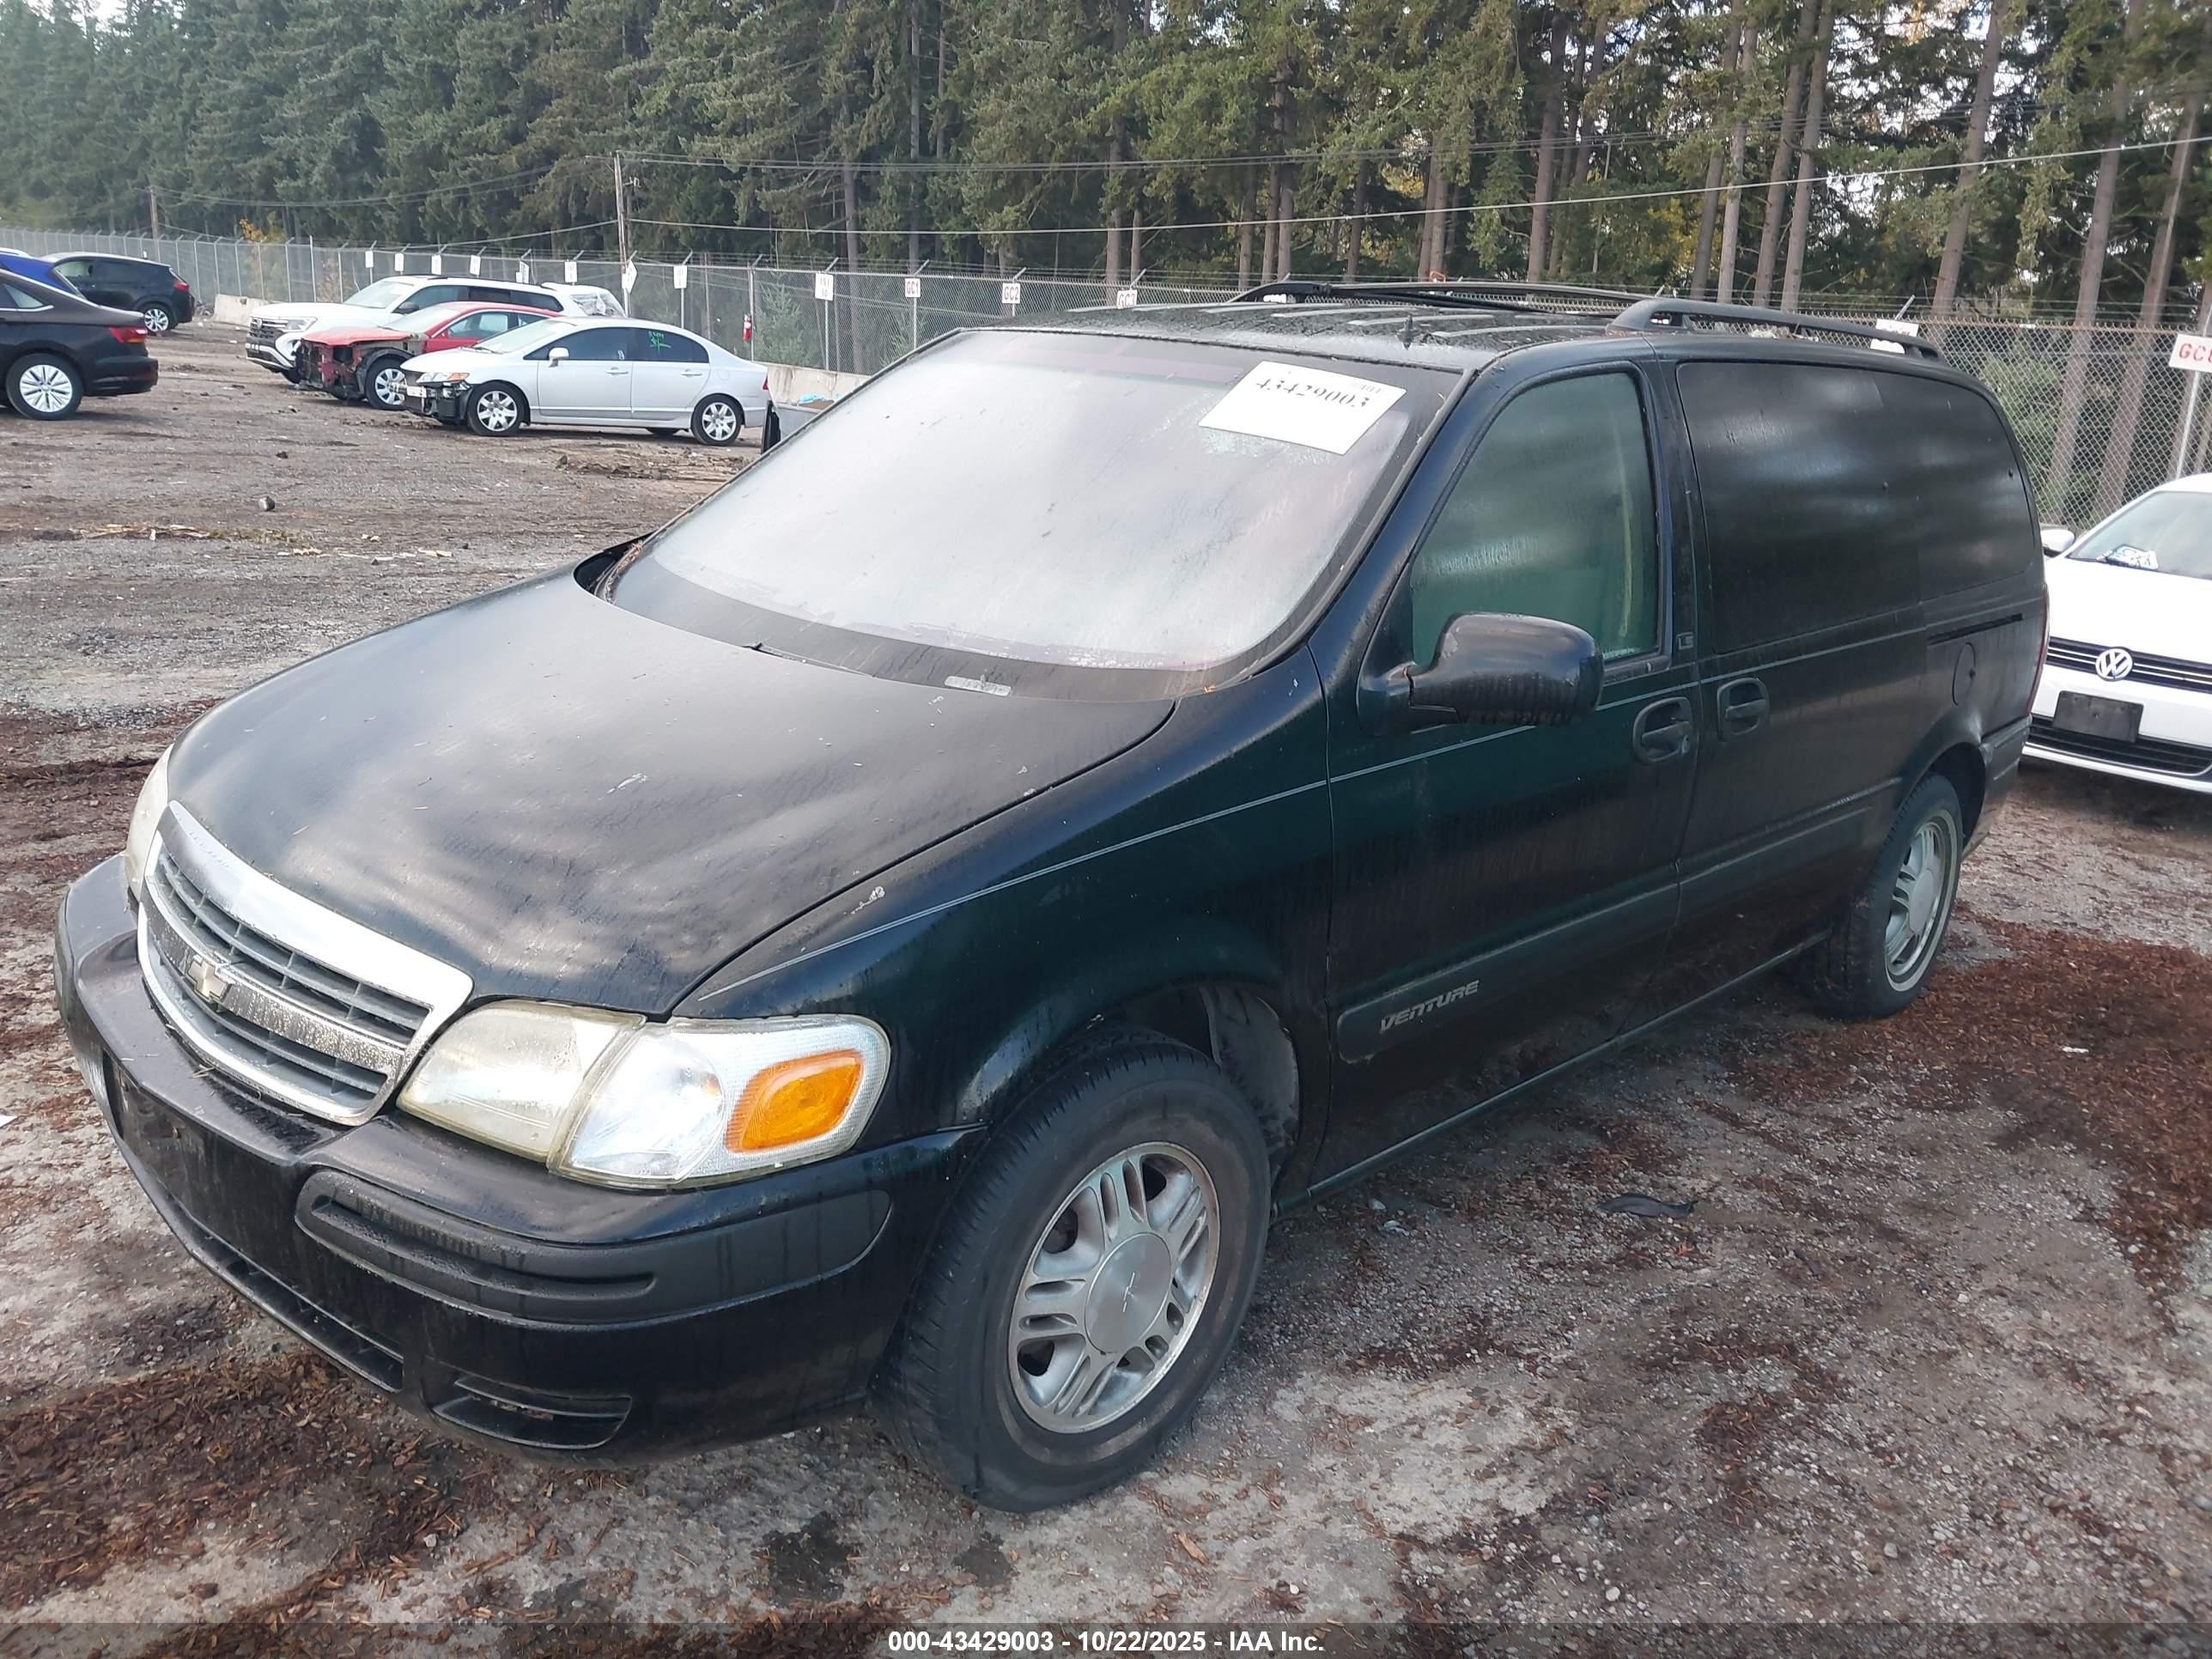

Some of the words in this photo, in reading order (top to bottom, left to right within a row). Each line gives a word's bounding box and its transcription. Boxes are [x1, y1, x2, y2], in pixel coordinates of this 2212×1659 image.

[907, 281, 919, 295] GC1
[1004, 286, 1019, 301] GC2
[1379, 980, 1480, 1034] VENTURE
